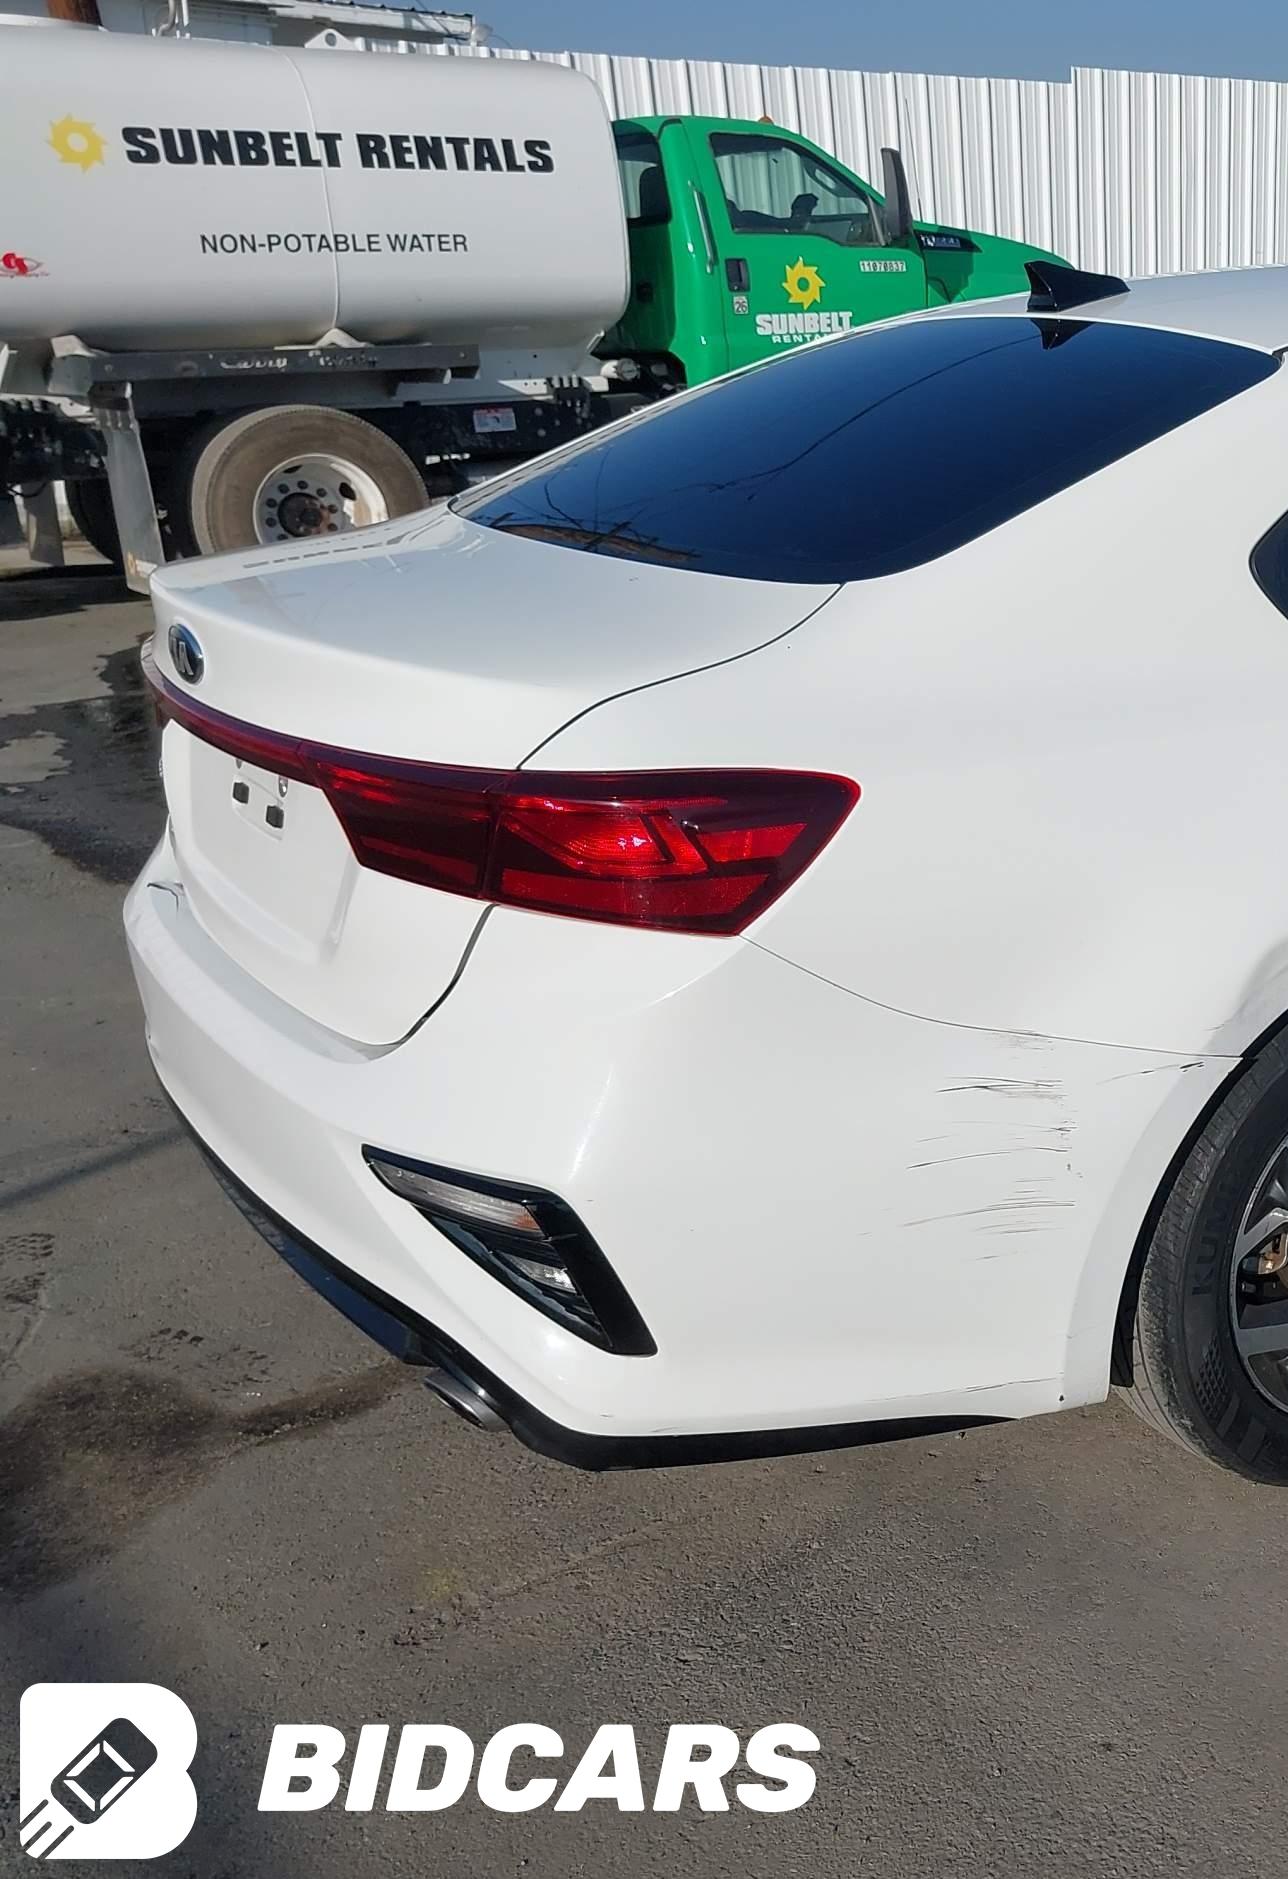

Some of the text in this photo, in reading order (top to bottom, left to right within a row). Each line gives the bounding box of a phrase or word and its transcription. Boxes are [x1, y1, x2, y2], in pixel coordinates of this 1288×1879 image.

[121, 126, 555, 173] SUNBELT RENTALS
[200, 233, 469, 253] NON-POTABLE WATER
[755, 311, 853, 336] SUNBELT
